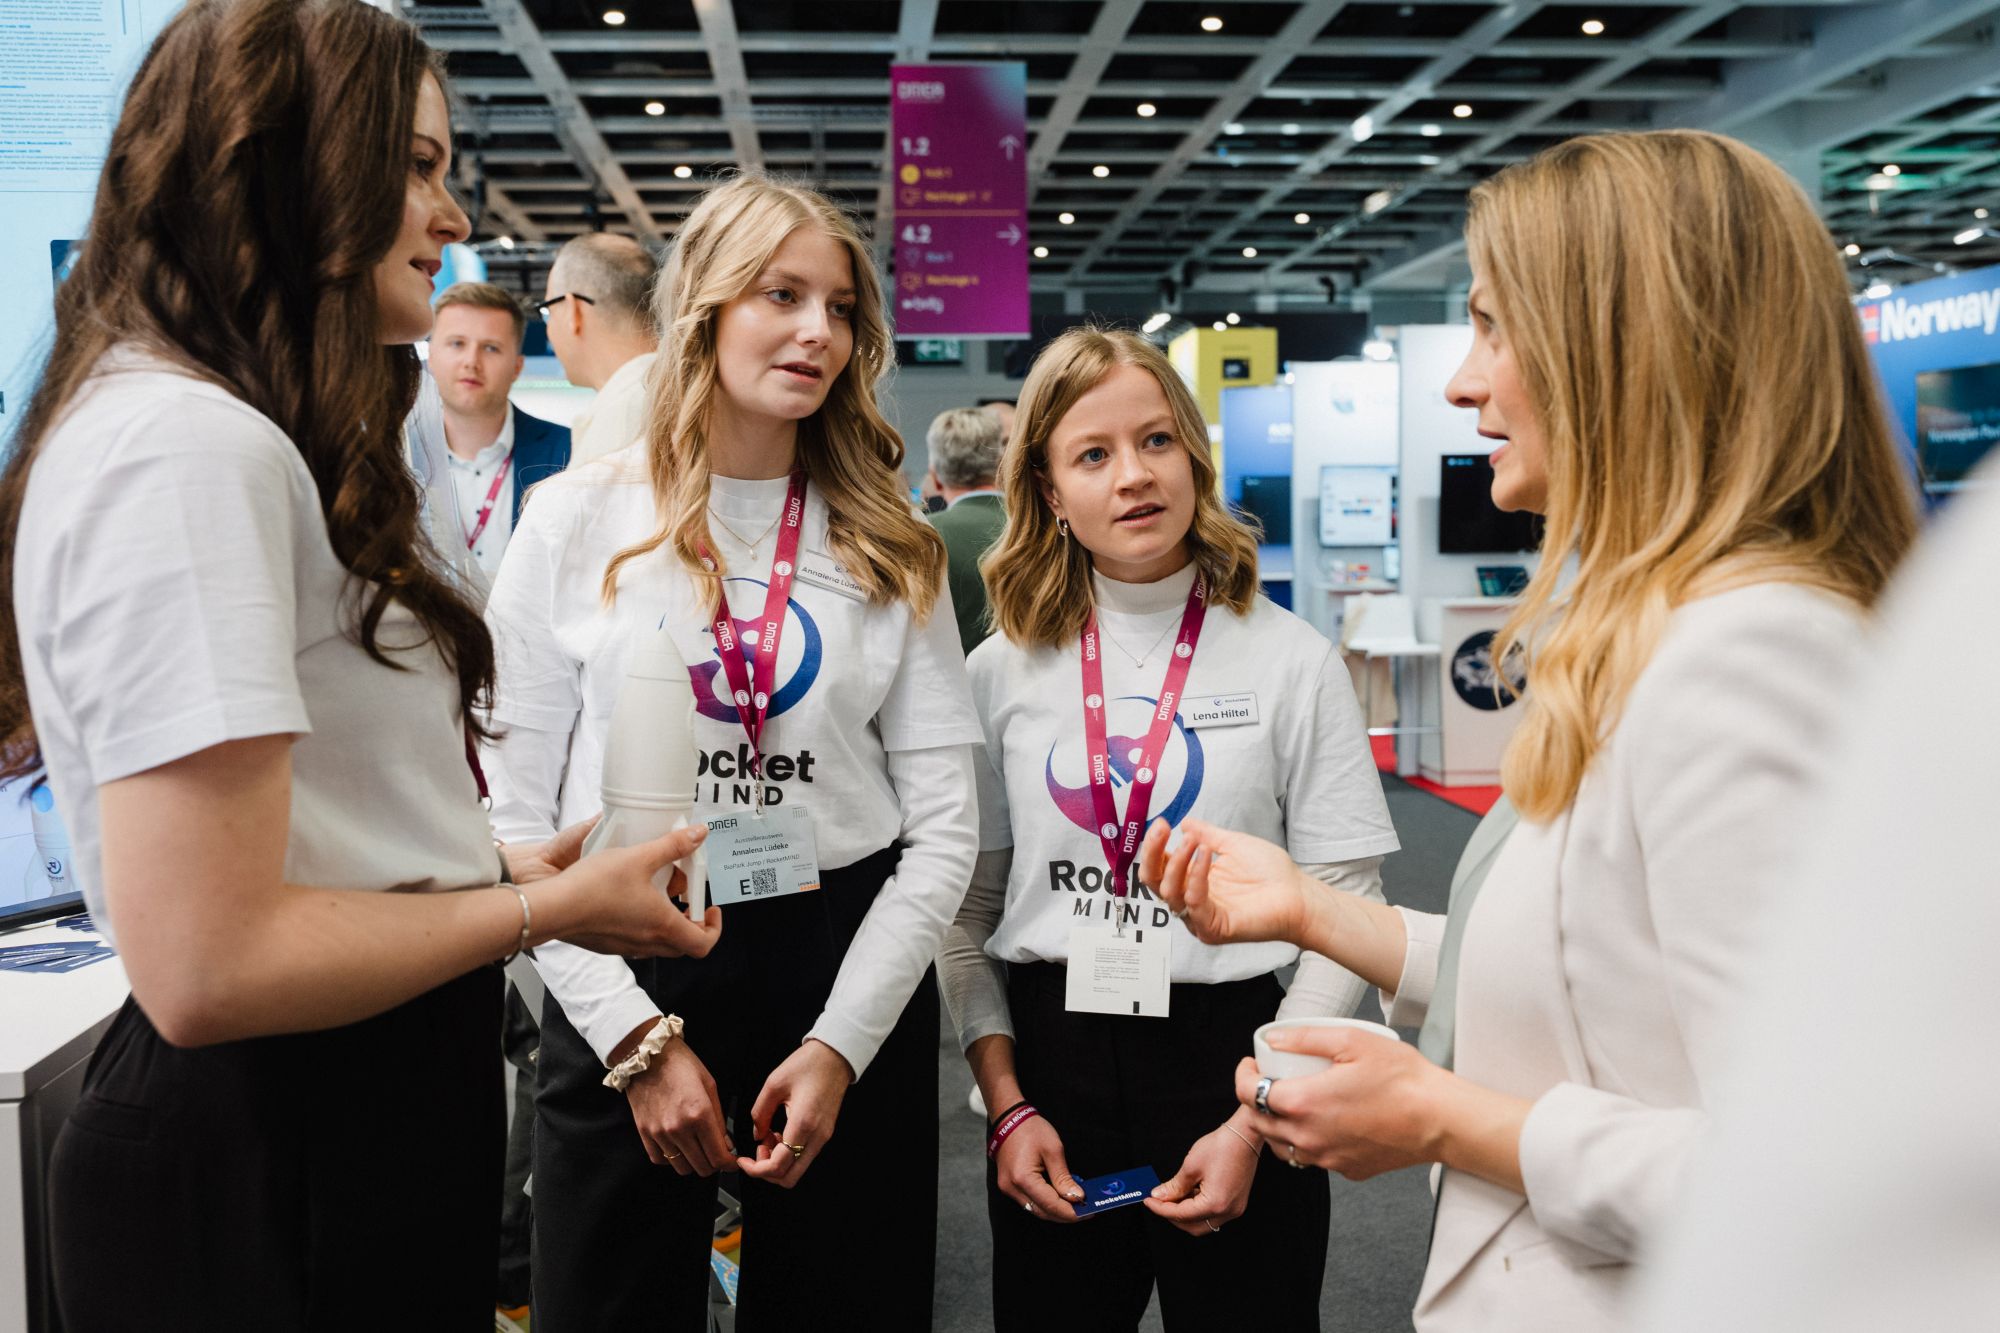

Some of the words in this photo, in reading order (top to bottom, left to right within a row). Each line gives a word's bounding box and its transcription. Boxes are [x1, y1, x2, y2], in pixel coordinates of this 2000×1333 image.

[901, 137, 930, 156] 1.2
[902, 224, 932, 243] 4.2
[1880, 288, 2000, 343] Norway
[787, 497, 801, 527] DMEA
[802, 566, 840, 584] Annalena
[716, 621, 735, 652] DMEA
[762, 622, 777, 653] DMEA
[1086, 632, 1096, 661] DMEA
[1158, 691, 1175, 721] DMEA
[1193, 712, 1219, 720] Lena
[1221, 708, 1249, 718] Hiltel
[1093, 754, 1106, 785] DMEA
[694, 783, 783, 806] IND
[707, 819, 738, 831] DMEA
[1123, 821, 1139, 853] DMEA
[732, 847, 763, 857] Annalena
[765, 843, 789, 852] Lüdeke
[740, 879, 752, 896] E
[1073, 897, 1170, 928] MIND
[999, 1120, 1014, 1136] TEAM
[1095, 1191, 1143, 1207] RocketMIND
